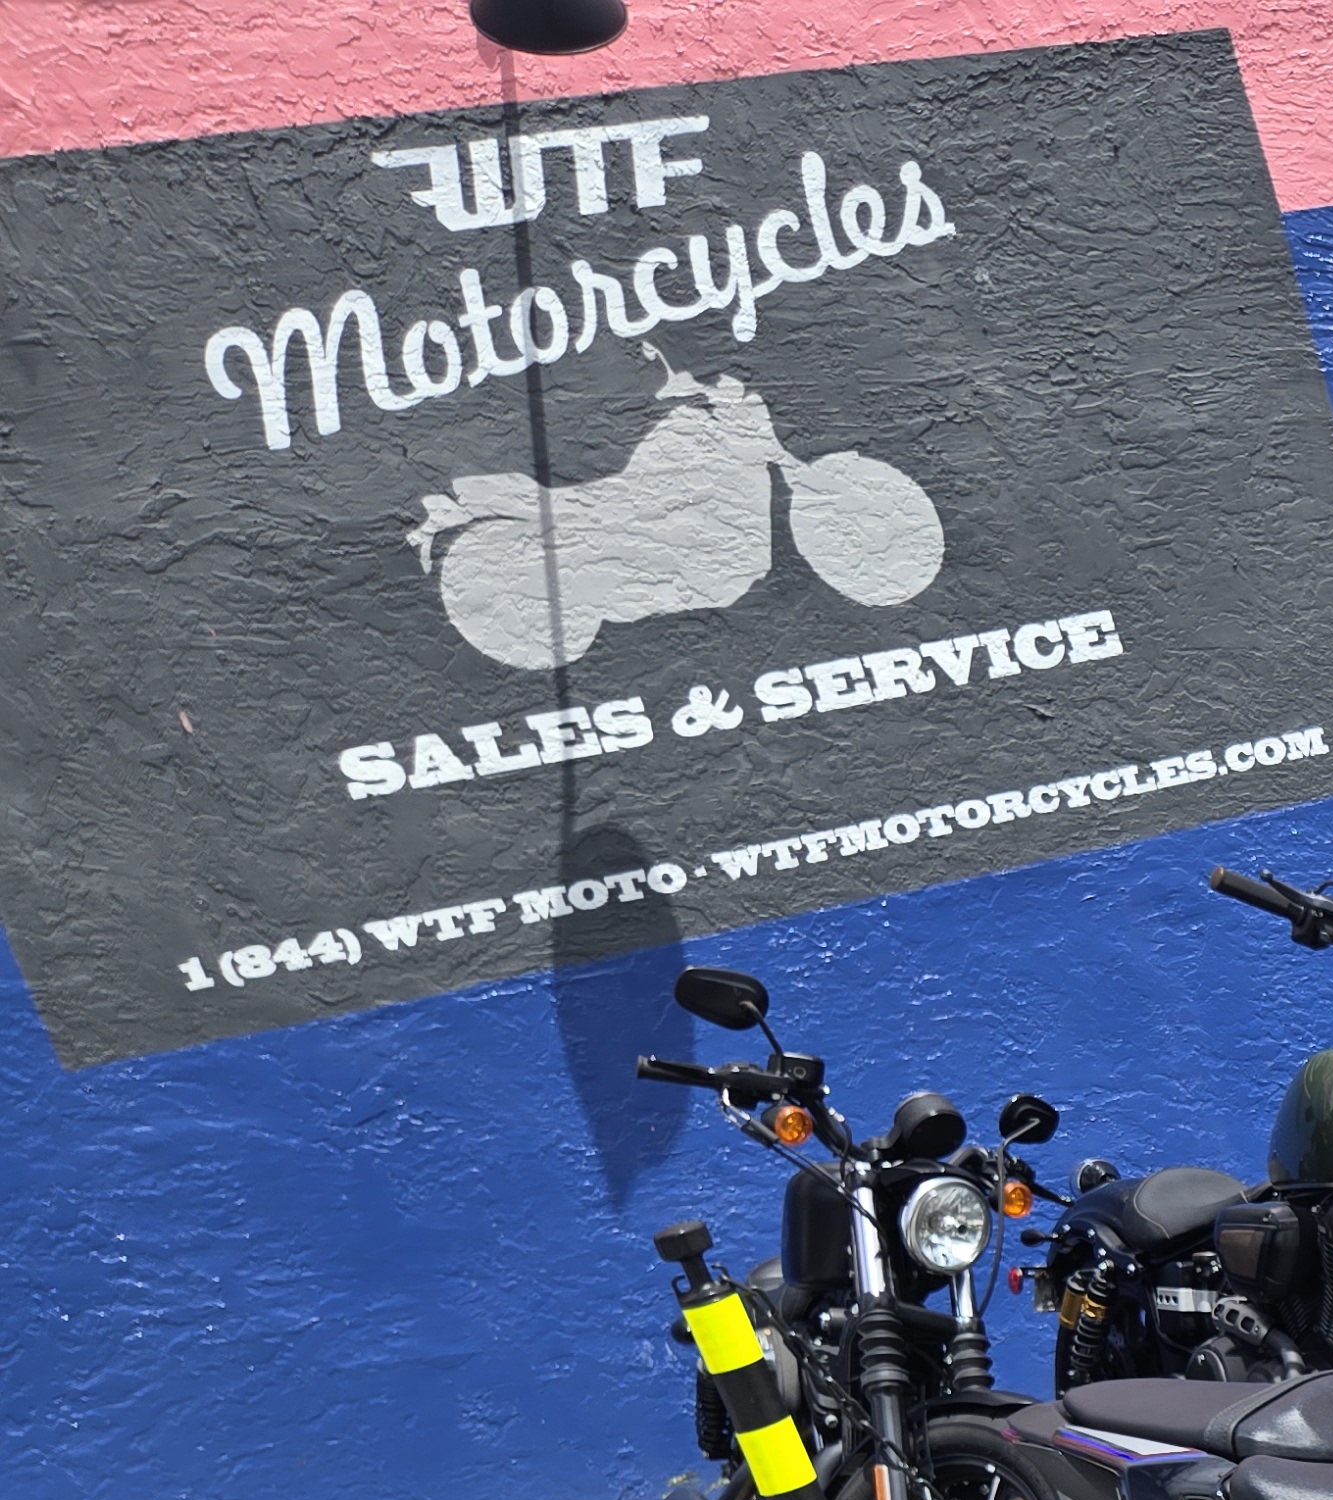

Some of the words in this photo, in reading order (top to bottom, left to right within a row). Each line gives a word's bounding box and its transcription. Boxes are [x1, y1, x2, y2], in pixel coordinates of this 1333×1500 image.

[371, 115, 710, 232] WTF
[204, 151, 957, 450] Motorcycles
[339, 696, 654, 800] SALES
[672, 684, 744, 738] &
[753, 609, 1124, 724] SERVICE
[178, 956, 213, 992] 1
[218, 926, 362, 988] (844)
[364, 897, 506, 952] WTF
